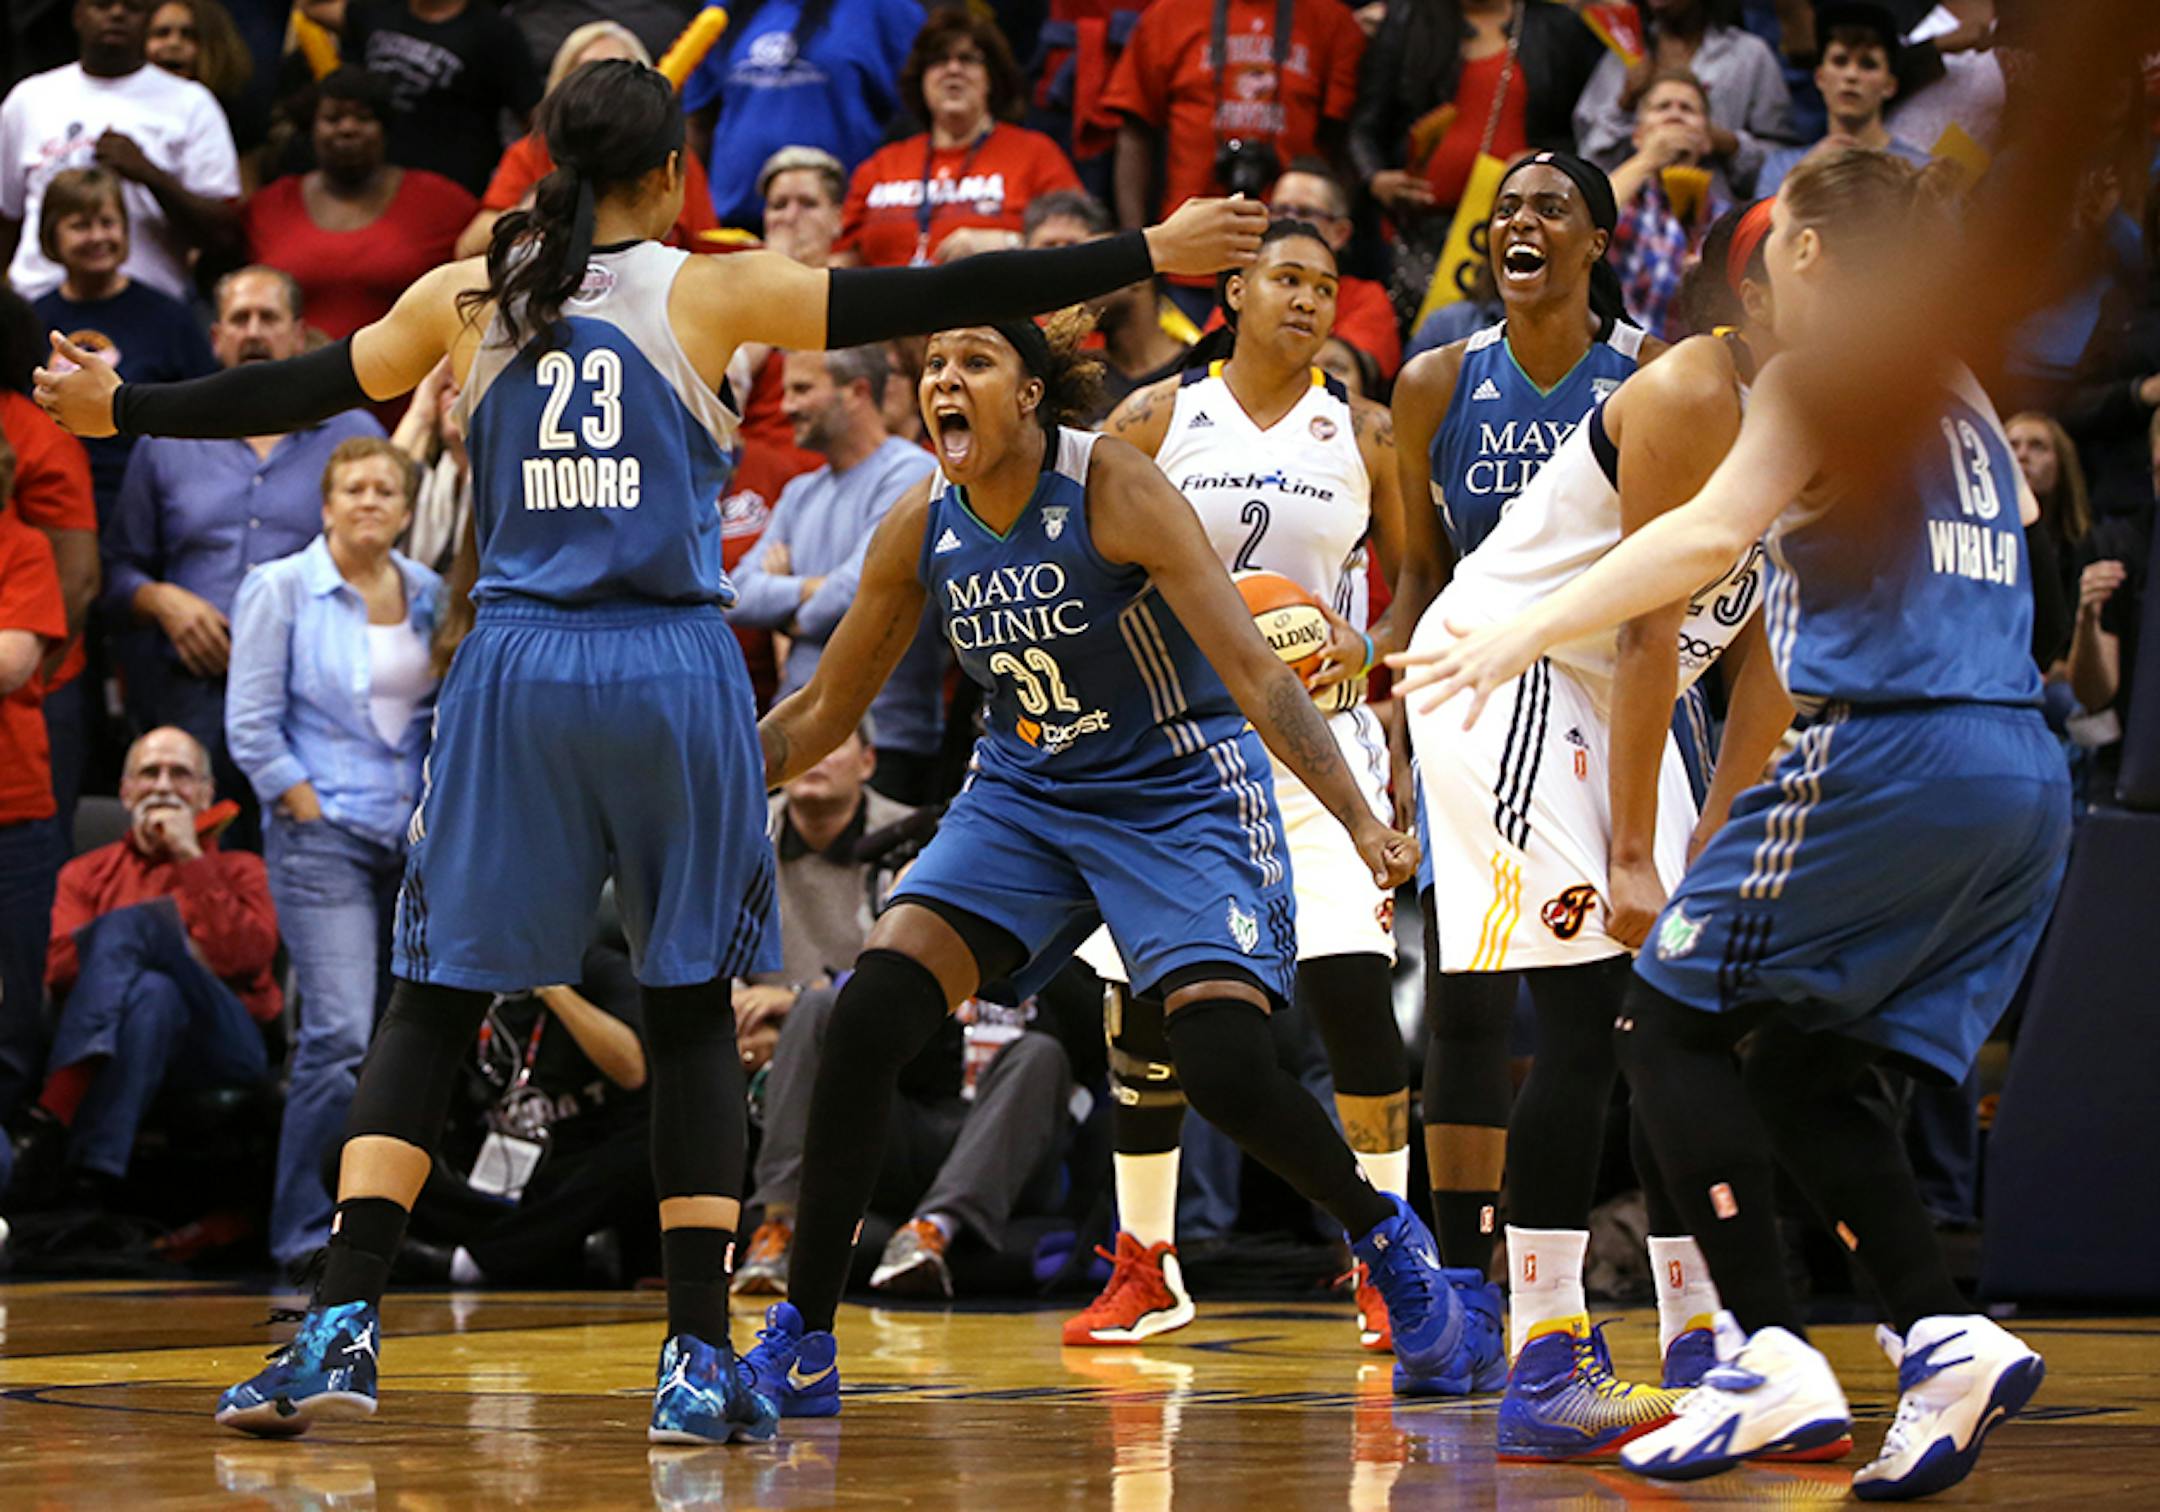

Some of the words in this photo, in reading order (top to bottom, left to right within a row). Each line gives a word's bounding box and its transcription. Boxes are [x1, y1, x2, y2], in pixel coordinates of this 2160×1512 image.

[536, 348, 623, 450] 23
[1478, 421, 1577, 455] MAY
[1180, 472, 1263, 493] Finish
[1940, 415, 2000, 520] 13
[1232, 499, 1271, 574] 2
[945, 561, 1067, 612] MAYO
[948, 599, 1091, 650] CLINIC
[989, 647, 1082, 716] 32
[1040, 708, 1111, 744] boost
